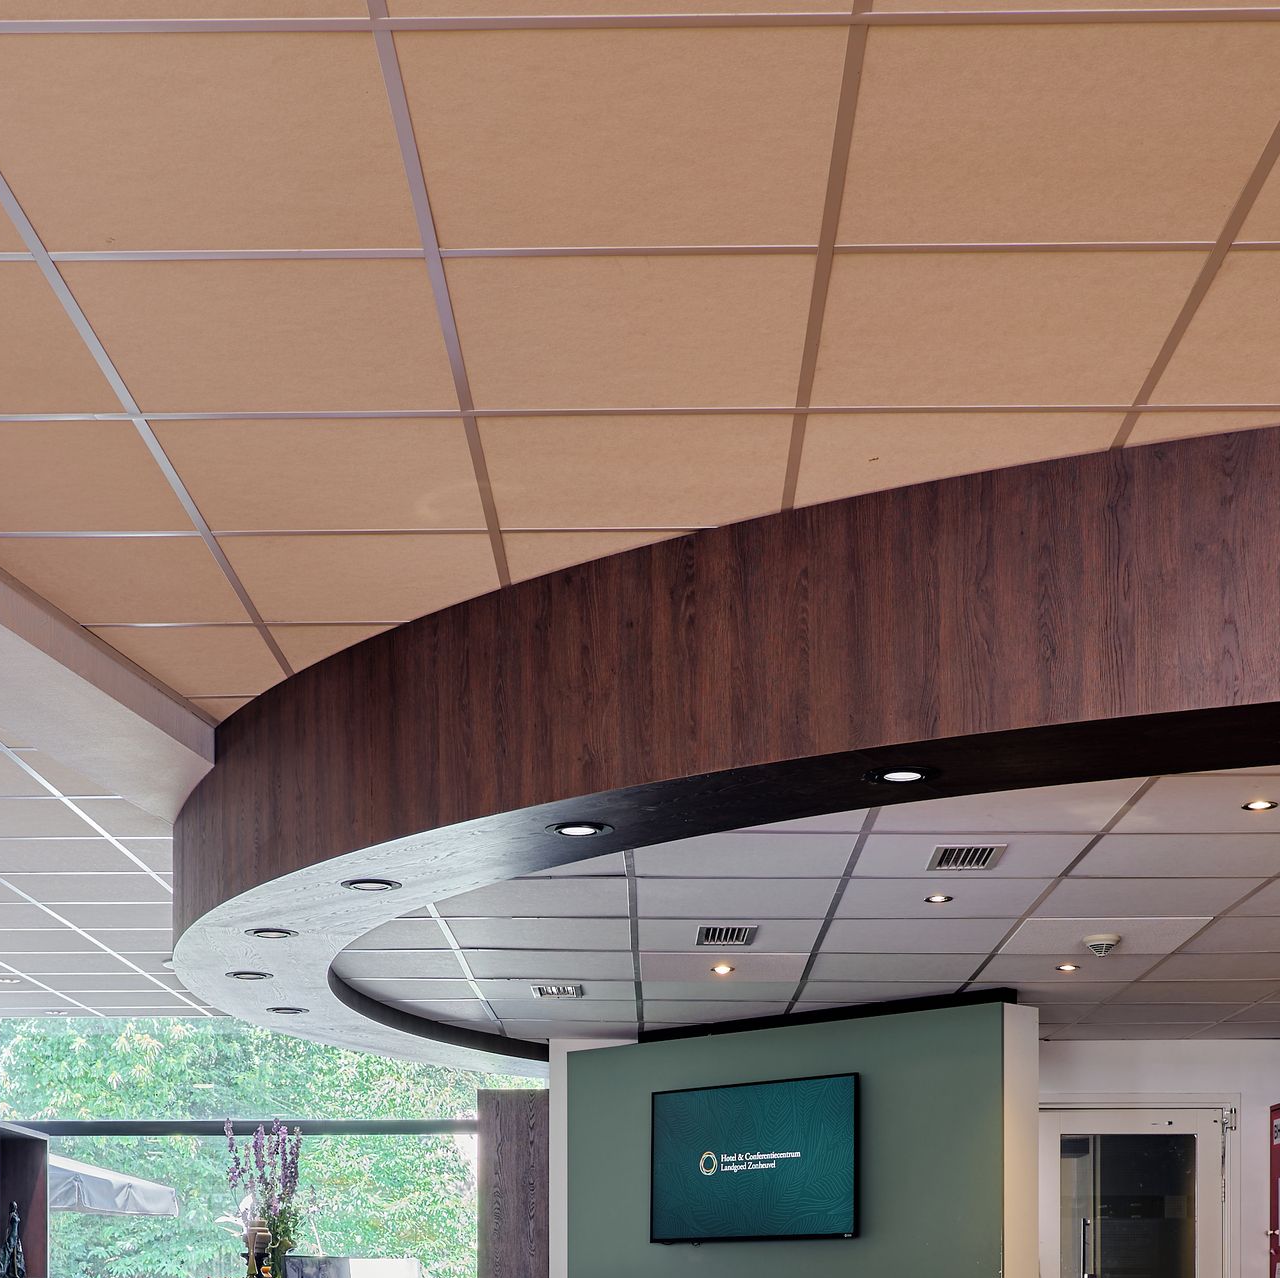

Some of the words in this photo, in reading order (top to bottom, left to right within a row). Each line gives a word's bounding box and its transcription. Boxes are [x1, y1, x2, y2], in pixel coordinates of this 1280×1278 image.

[721, 1154, 736, 1162] Hotel
[744, 1152, 800, 1160] Conferentiecentrum
[721, 1162, 746, 1172] Landgoed
[748, 1160, 776, 1169] Zonheuvel
